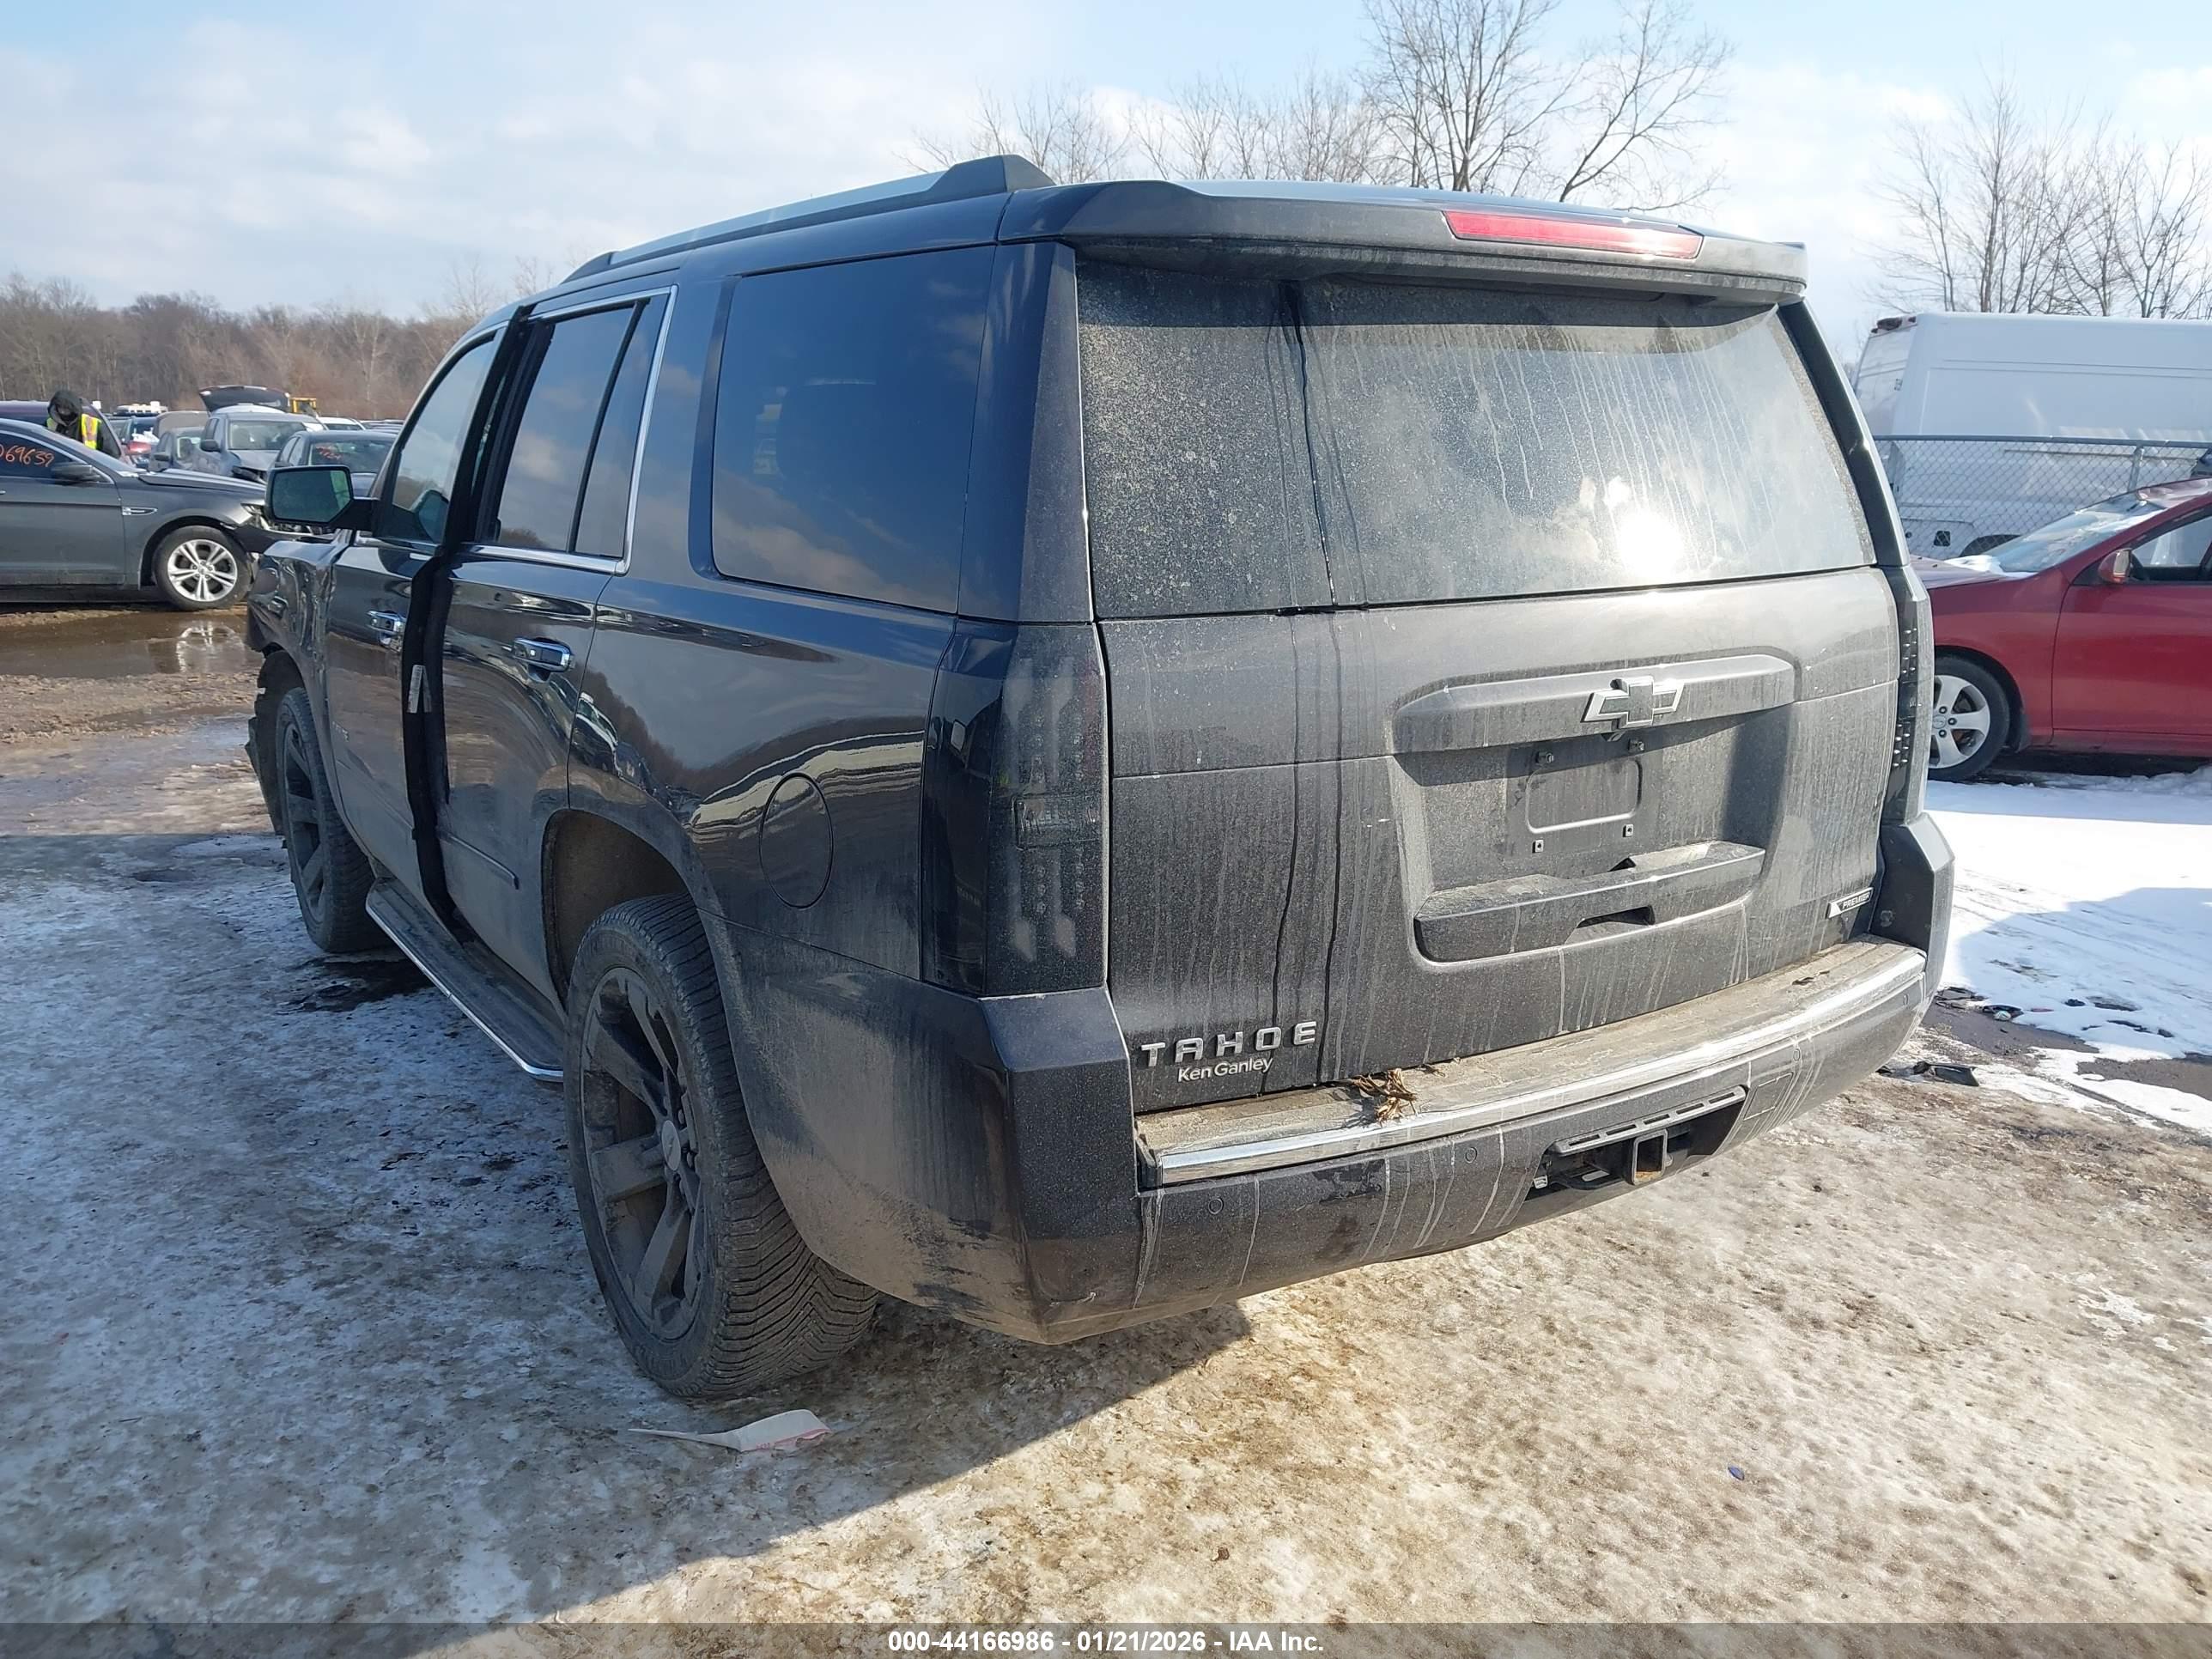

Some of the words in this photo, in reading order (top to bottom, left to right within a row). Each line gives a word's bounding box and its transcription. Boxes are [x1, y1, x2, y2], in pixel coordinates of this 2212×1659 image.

[1140, 1021, 1316, 1067] TAHOE
[1177, 1066, 1212, 1082] Ken
[1213, 1057, 1273, 1079] Ganley
